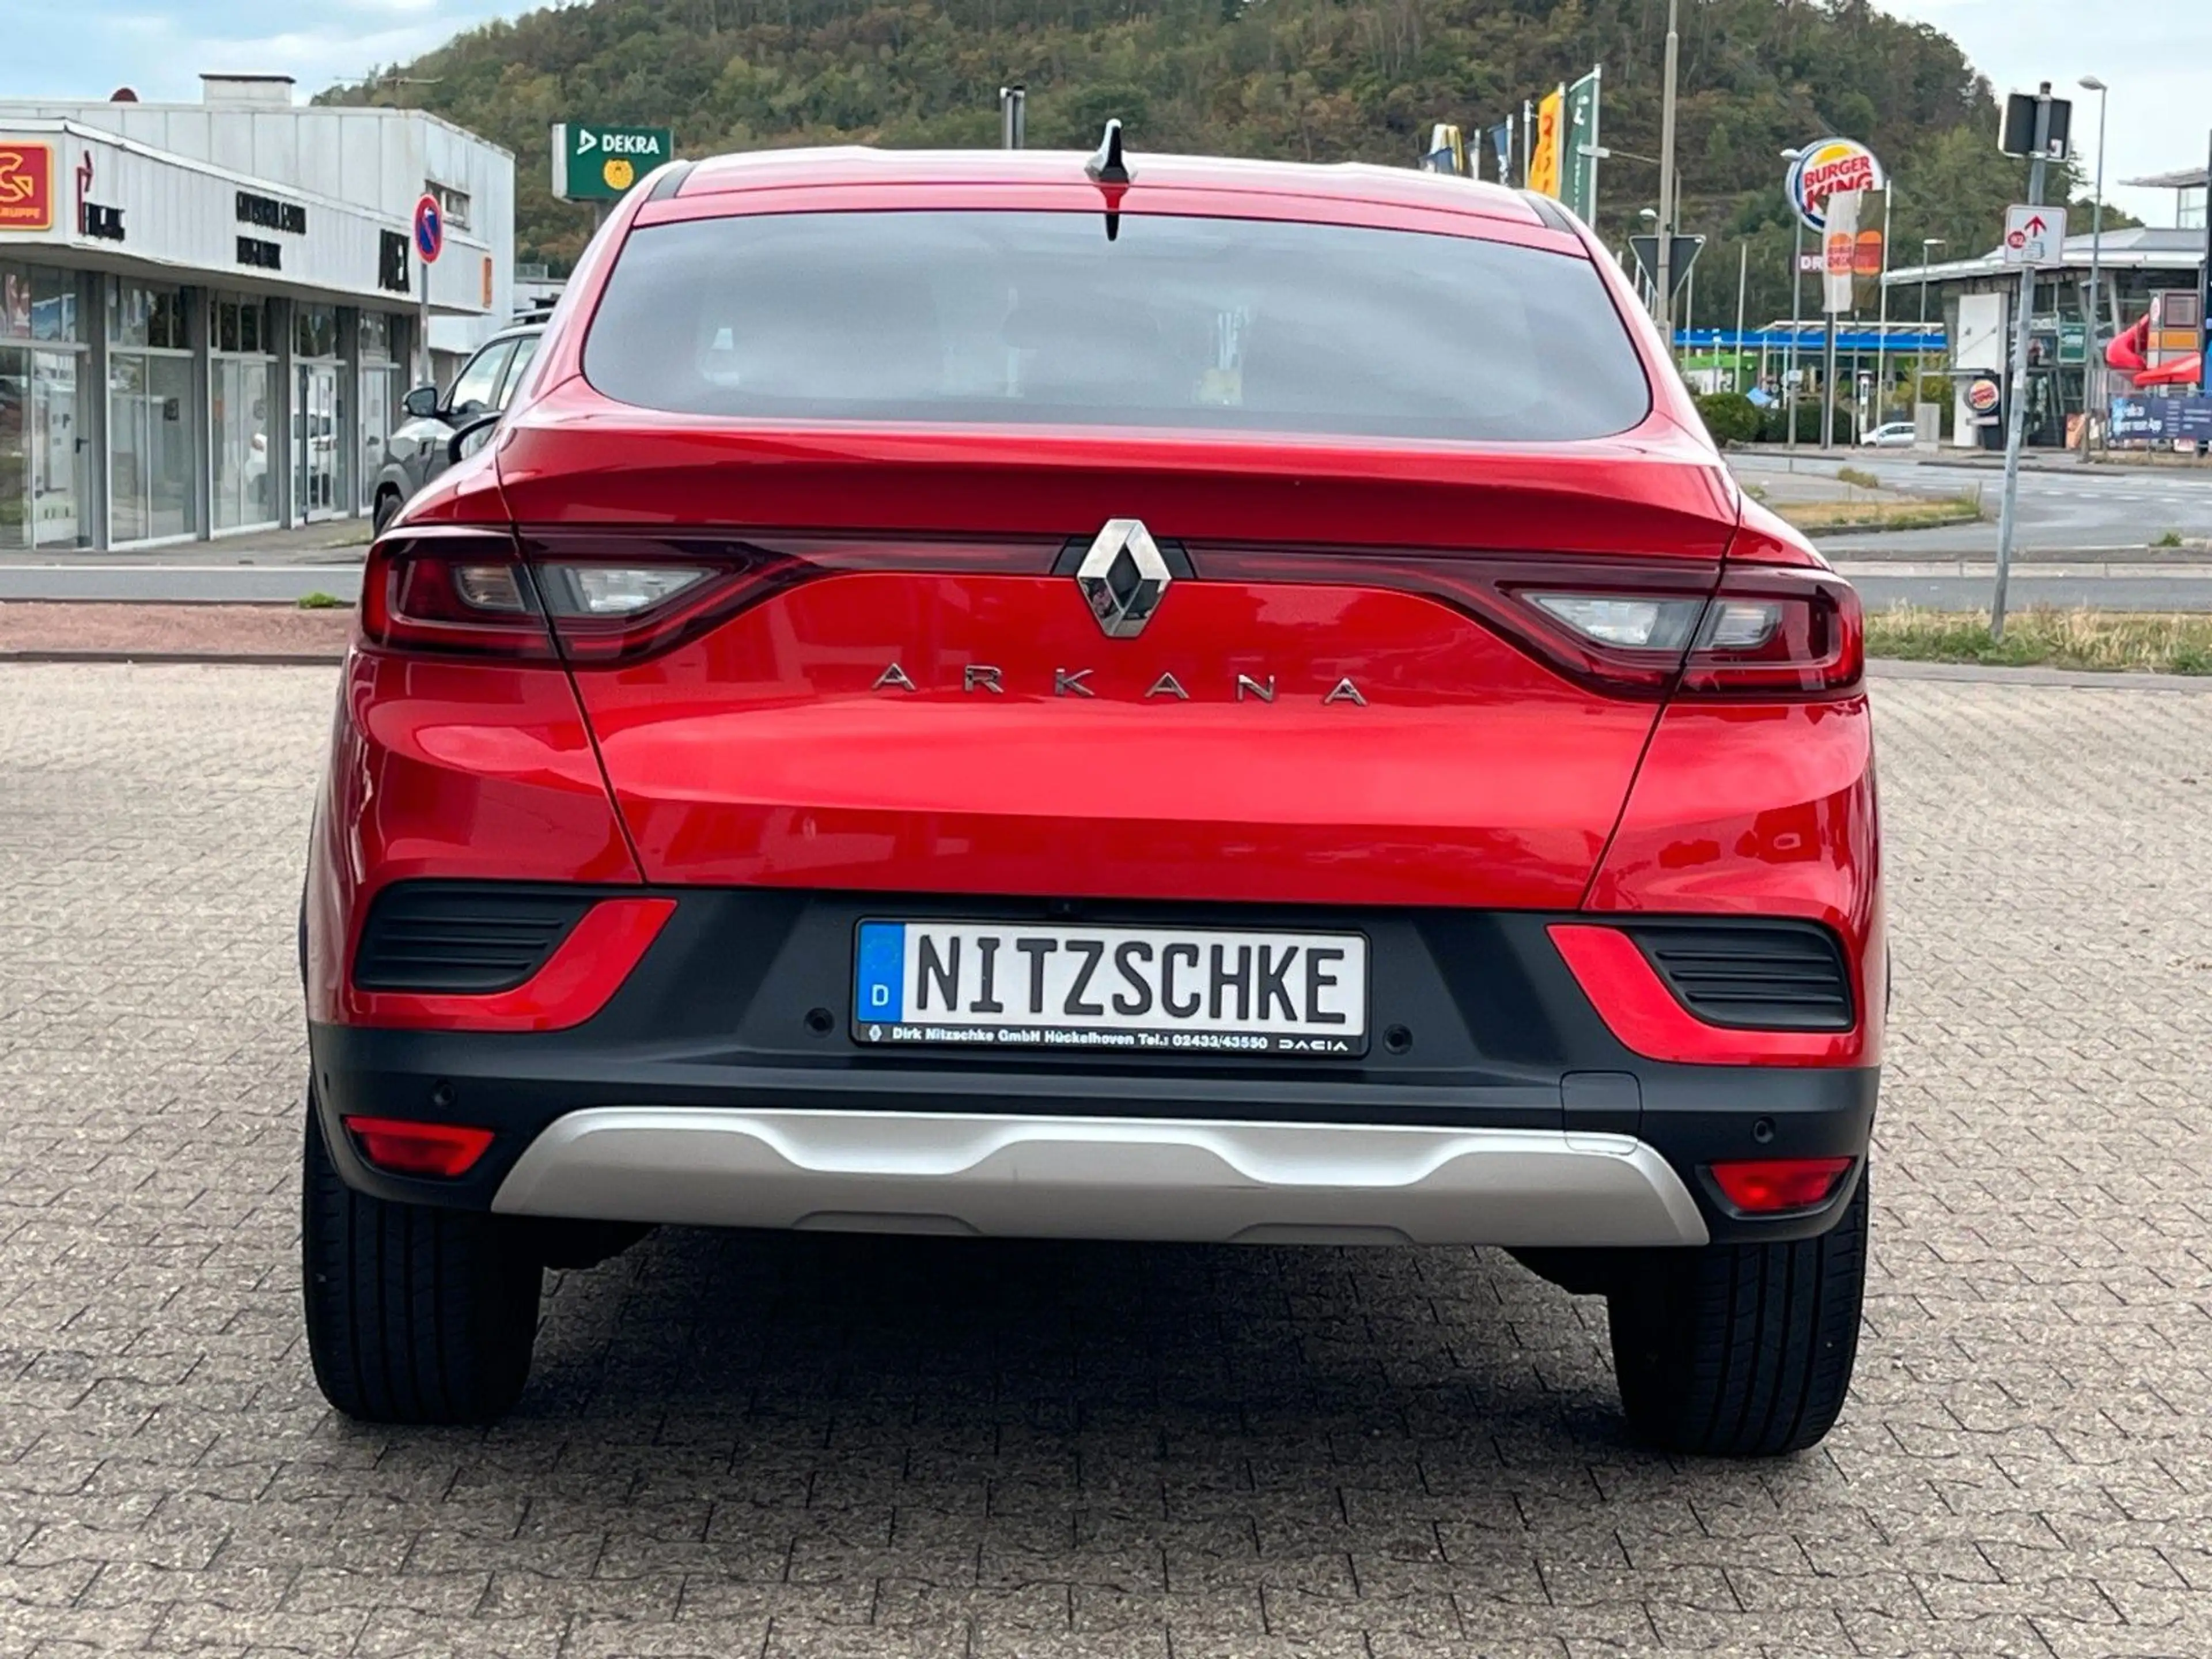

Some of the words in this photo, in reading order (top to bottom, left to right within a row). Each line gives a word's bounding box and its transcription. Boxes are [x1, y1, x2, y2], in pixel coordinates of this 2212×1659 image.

[602, 134, 660, 154] DEKRA
[1804, 156, 1870, 188] BURGER
[872, 662, 1370, 707] ARKANA
[916, 934, 1347, 1024] NITZSCHKE
[872, 983, 889, 1007] D
[892, 1027, 922, 1040] Dirk
[998, 1029, 1040, 1043] GmbH
[1278, 1039, 1349, 1051] DACIA
